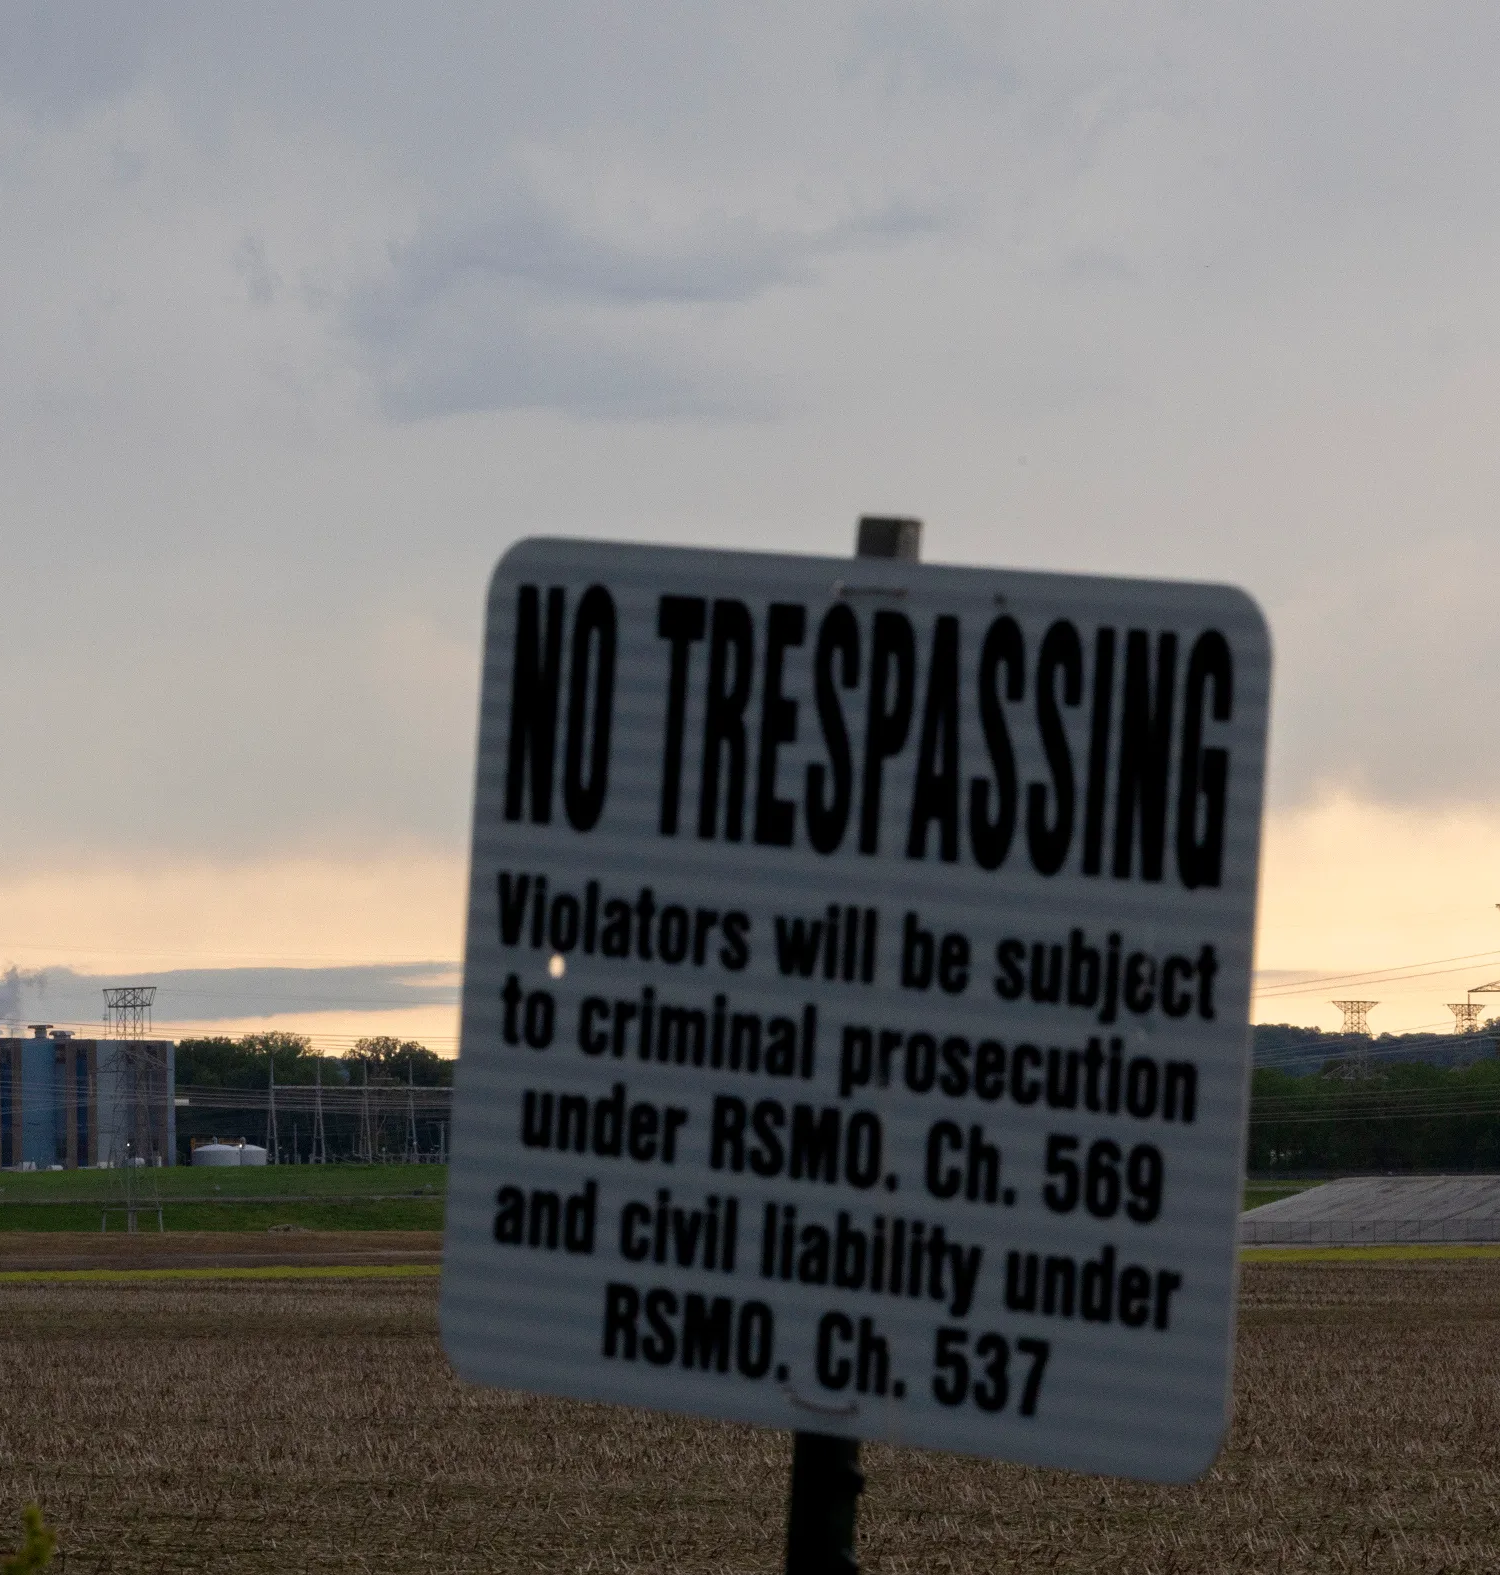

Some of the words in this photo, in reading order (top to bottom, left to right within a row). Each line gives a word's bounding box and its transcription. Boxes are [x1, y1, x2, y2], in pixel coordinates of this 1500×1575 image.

[501, 582, 620, 835] NO
[654, 593, 1236, 892] TRESPASSING
[496, 870, 753, 974] Violators
[772, 902, 881, 986] will
[899, 910, 972, 997] be
[992, 927, 1220, 1027] subject
[499, 971, 558, 1052] to
[575, 984, 819, 1082] criminal
[837, 1023, 1199, 1126] prosecution
[518, 1080, 691, 1166] under
[707, 1092, 901, 1194] RSMO.
[923, 1117, 1018, 1209] Ch.
[1040, 1131, 1166, 1227] 569
[491, 1177, 601, 1257] and
[617, 1186, 741, 1276] civil
[758, 1199, 985, 1320] liability
[1002, 1241, 1185, 1333] under
[600, 1280, 791, 1386] RSMO.
[813, 1309, 908, 1403] Ch.
[930, 1324, 1052, 1420] 537
